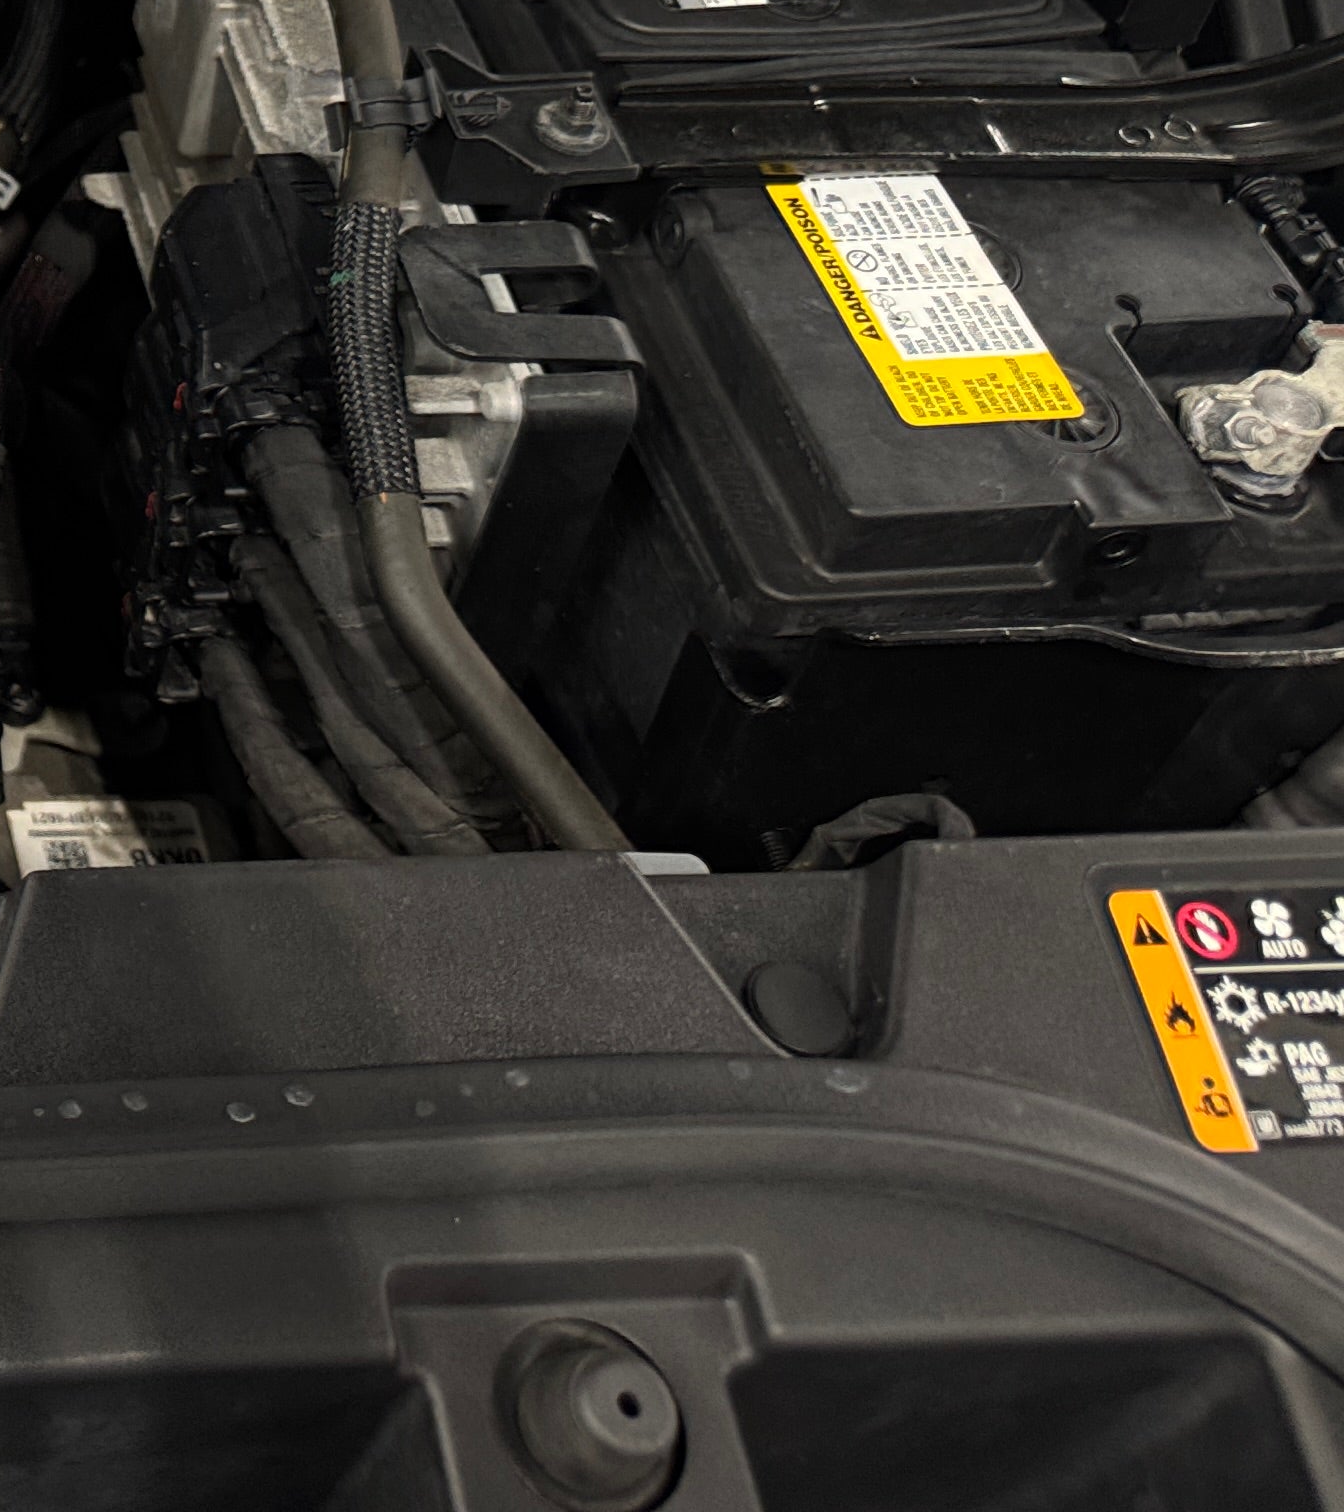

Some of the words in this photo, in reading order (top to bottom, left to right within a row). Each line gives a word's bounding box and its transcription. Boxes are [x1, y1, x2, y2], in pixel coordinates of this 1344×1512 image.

[782, 197, 873, 323] DANGER/POISON
[1261, 939, 1308, 959] AUTO
[1283, 1042, 1330, 1067] PAG
